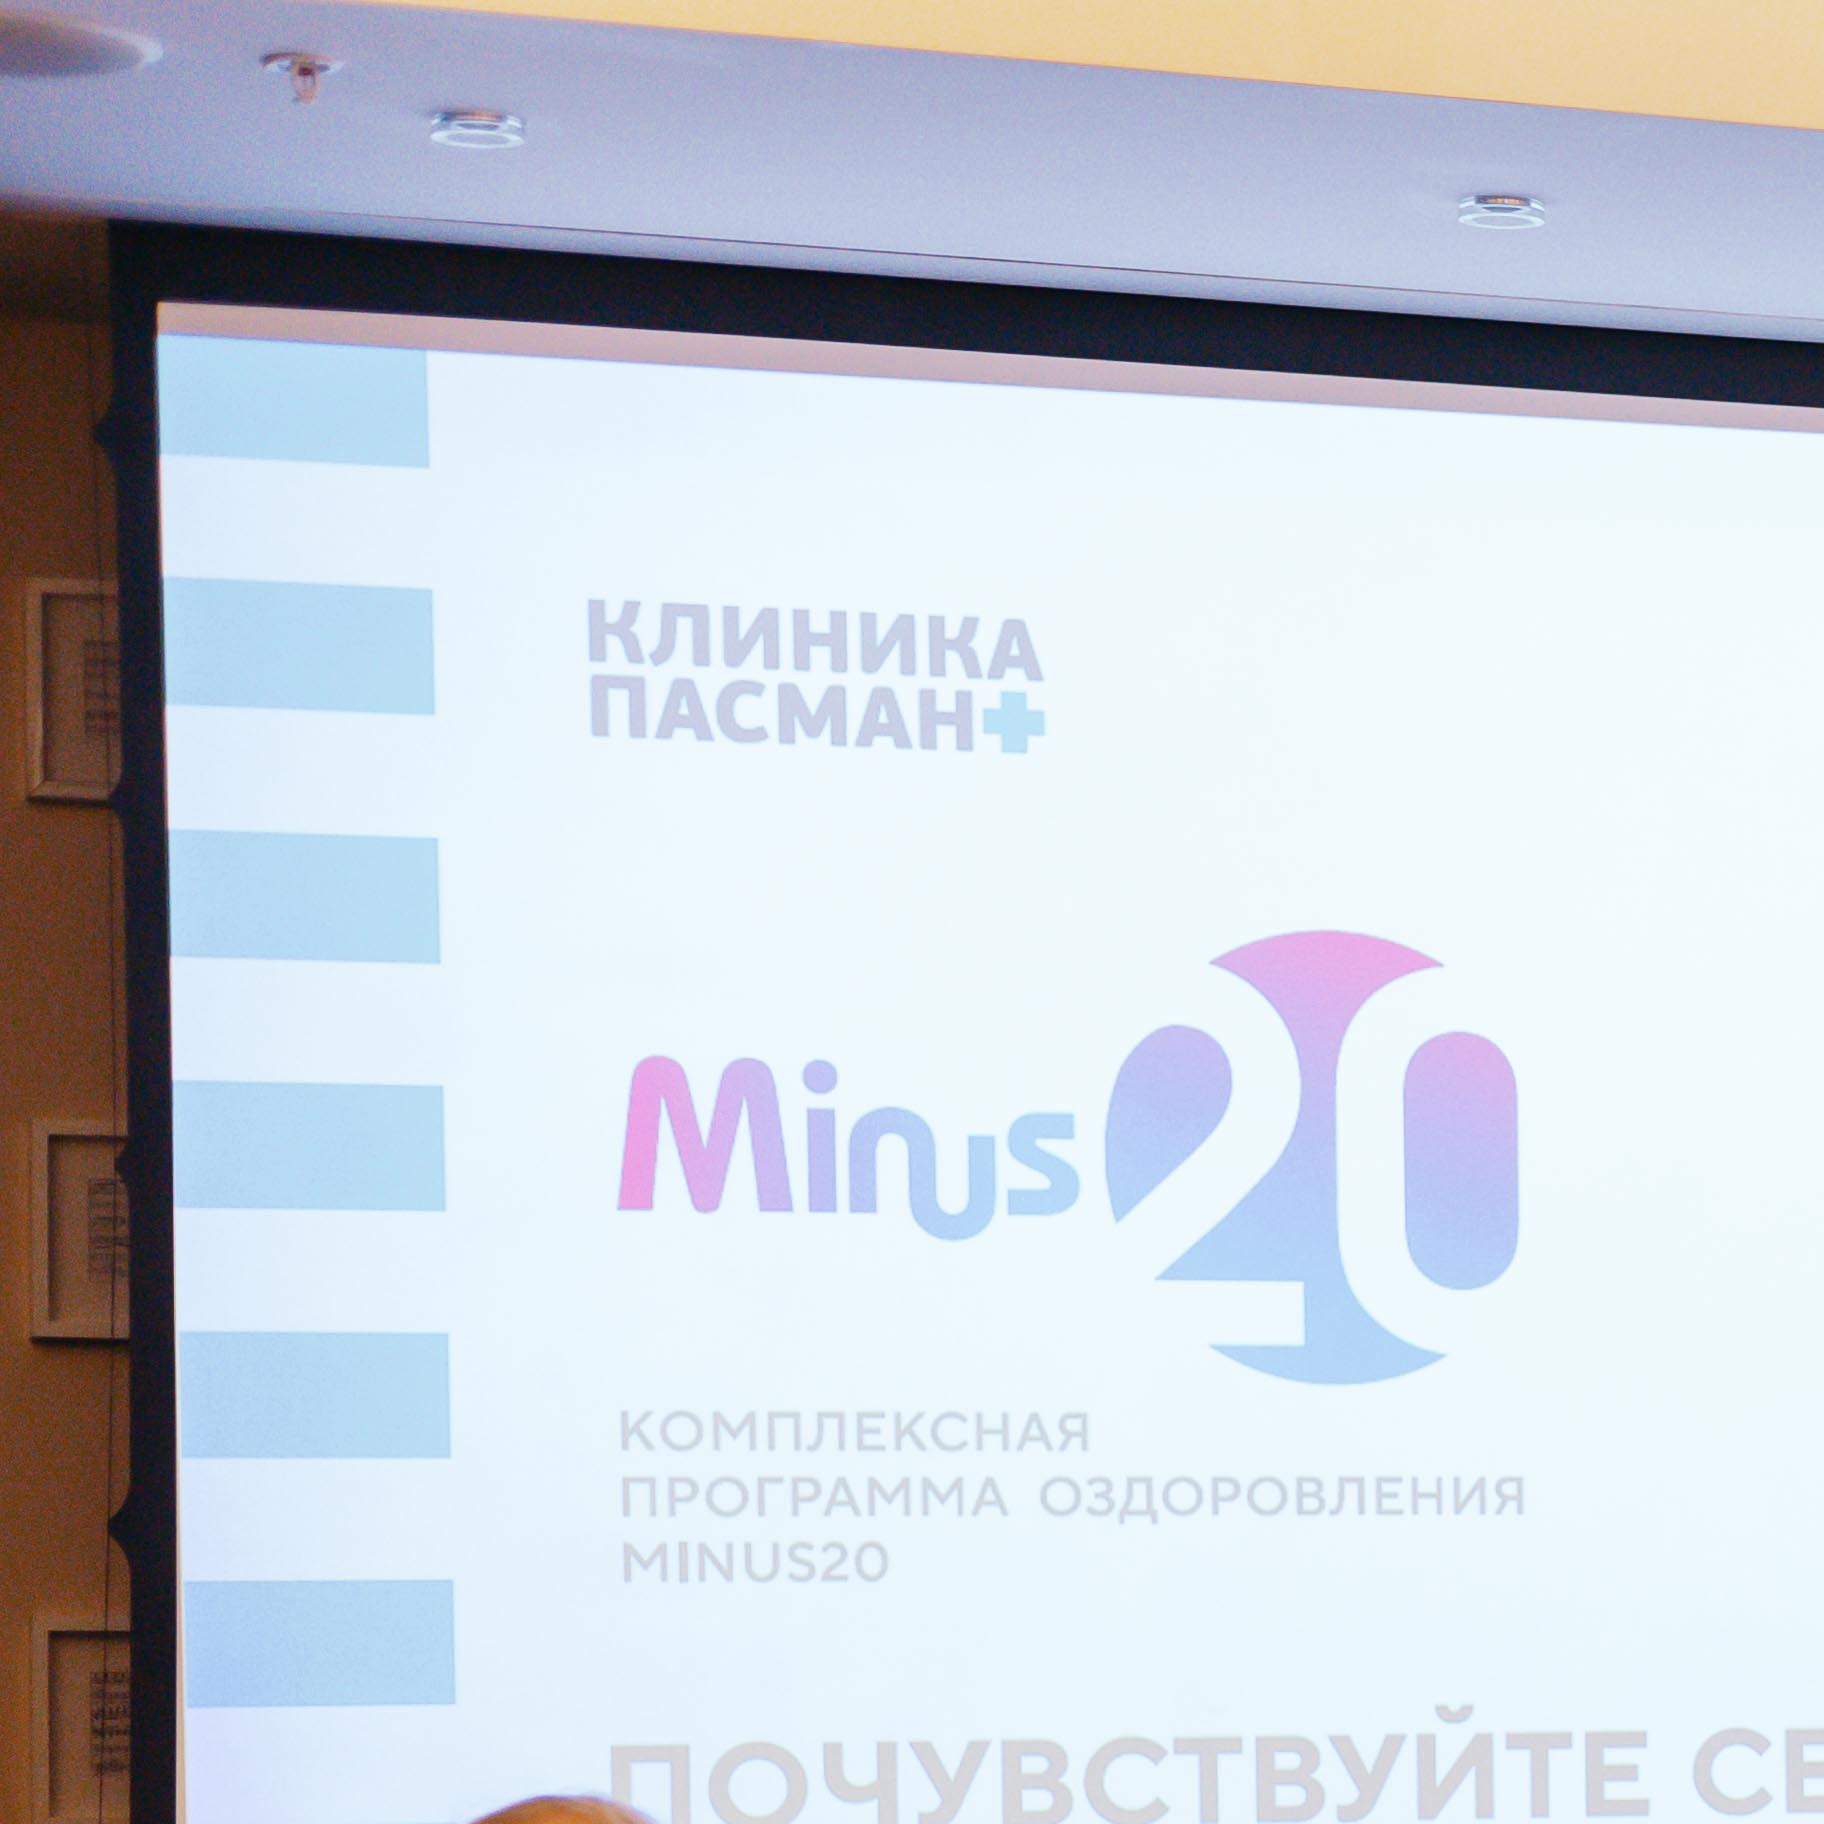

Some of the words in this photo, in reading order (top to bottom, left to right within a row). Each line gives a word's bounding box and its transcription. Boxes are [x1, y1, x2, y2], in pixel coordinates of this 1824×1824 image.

[587, 598, 1044, 682] КЛИНИКА
[620, 1410, 1090, 1452] КОМПЛЕКСНАЯ
[621, 1475, 1009, 1517] ПРОГРАММА
[1039, 1475, 1525, 1524] ОЗДОРОВЛЕНИЯ
[622, 1540, 889, 1583] MINUS20
